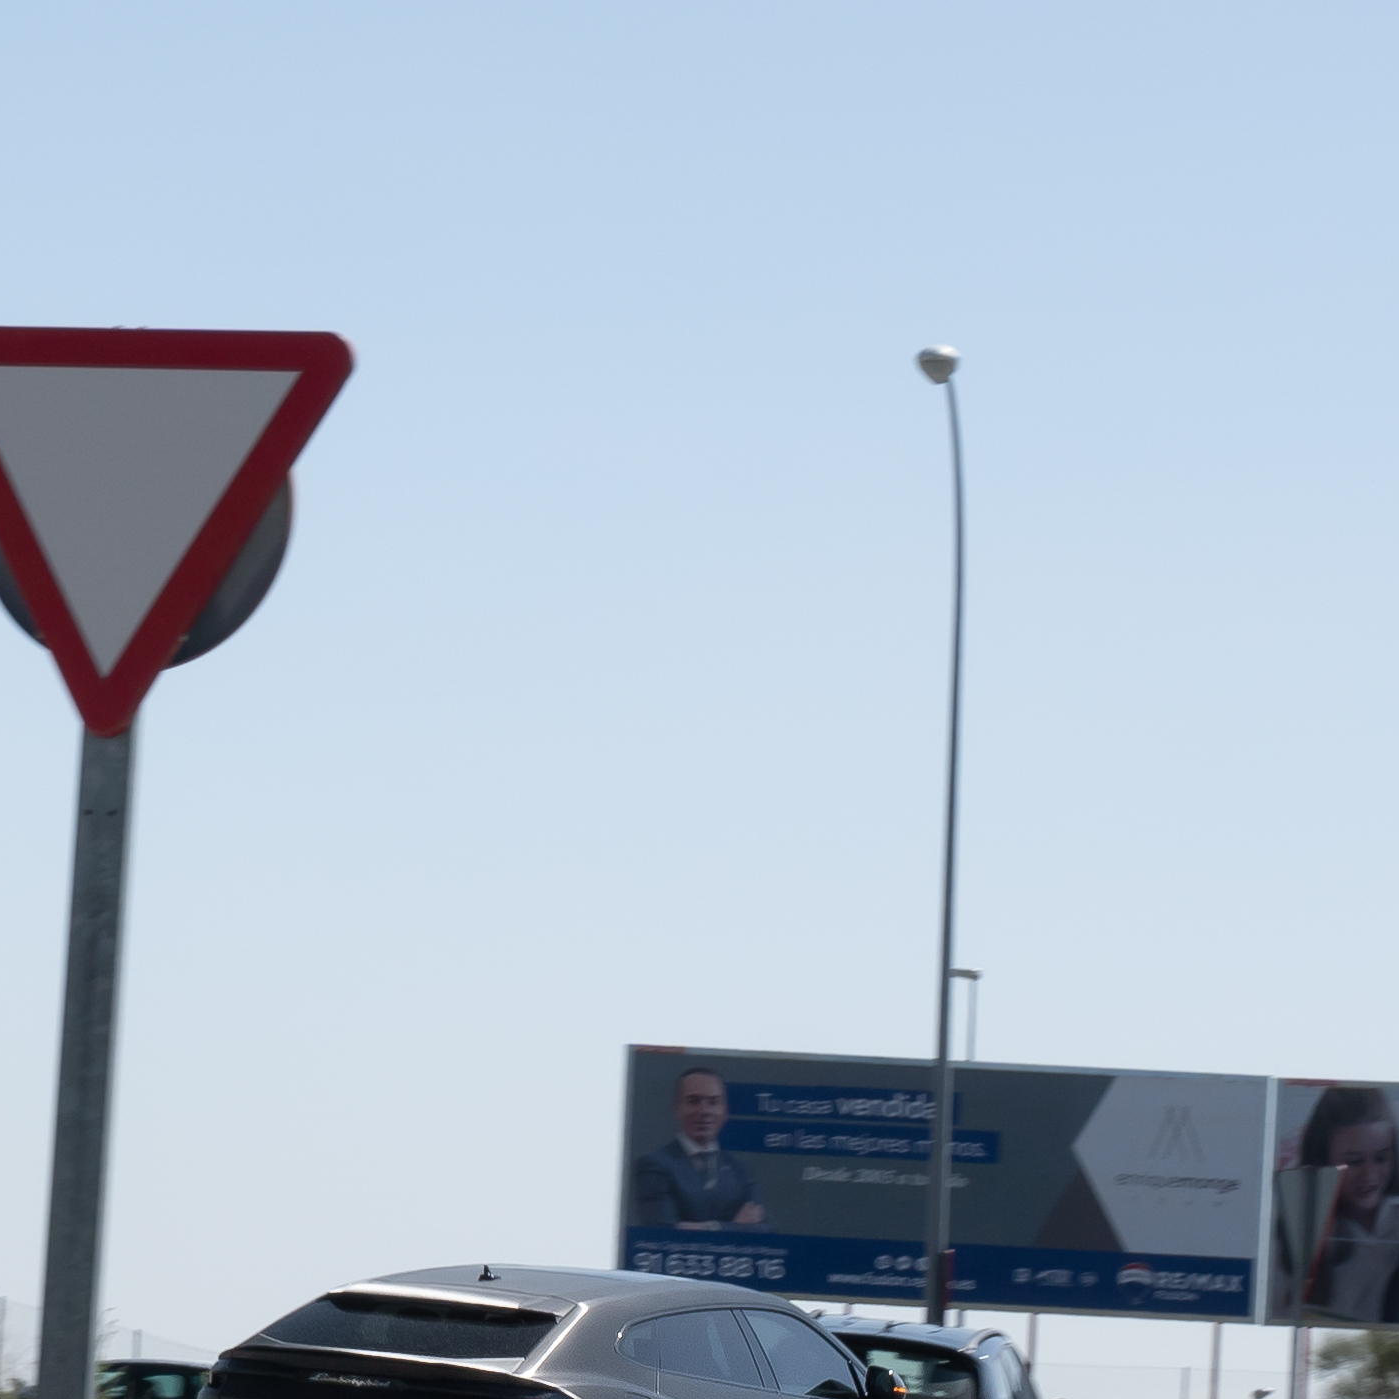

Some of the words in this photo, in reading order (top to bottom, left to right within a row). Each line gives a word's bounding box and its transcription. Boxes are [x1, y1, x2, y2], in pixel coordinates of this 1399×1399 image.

[755, 1093, 781, 1112] Tu
[783, 1100, 834, 1114] casa
[764, 1133, 792, 1147] en
[794, 1129, 827, 1149] las
[828, 1132, 911, 1155] mejores
[913, 1139, 988, 1157] mnos.
[635, 1252, 662, 1272] 91
[664, 1254, 717, 1276] 633
[756, 1258, 786, 1280] 16
[1153, 1271, 1244, 1293] RE/MAX
